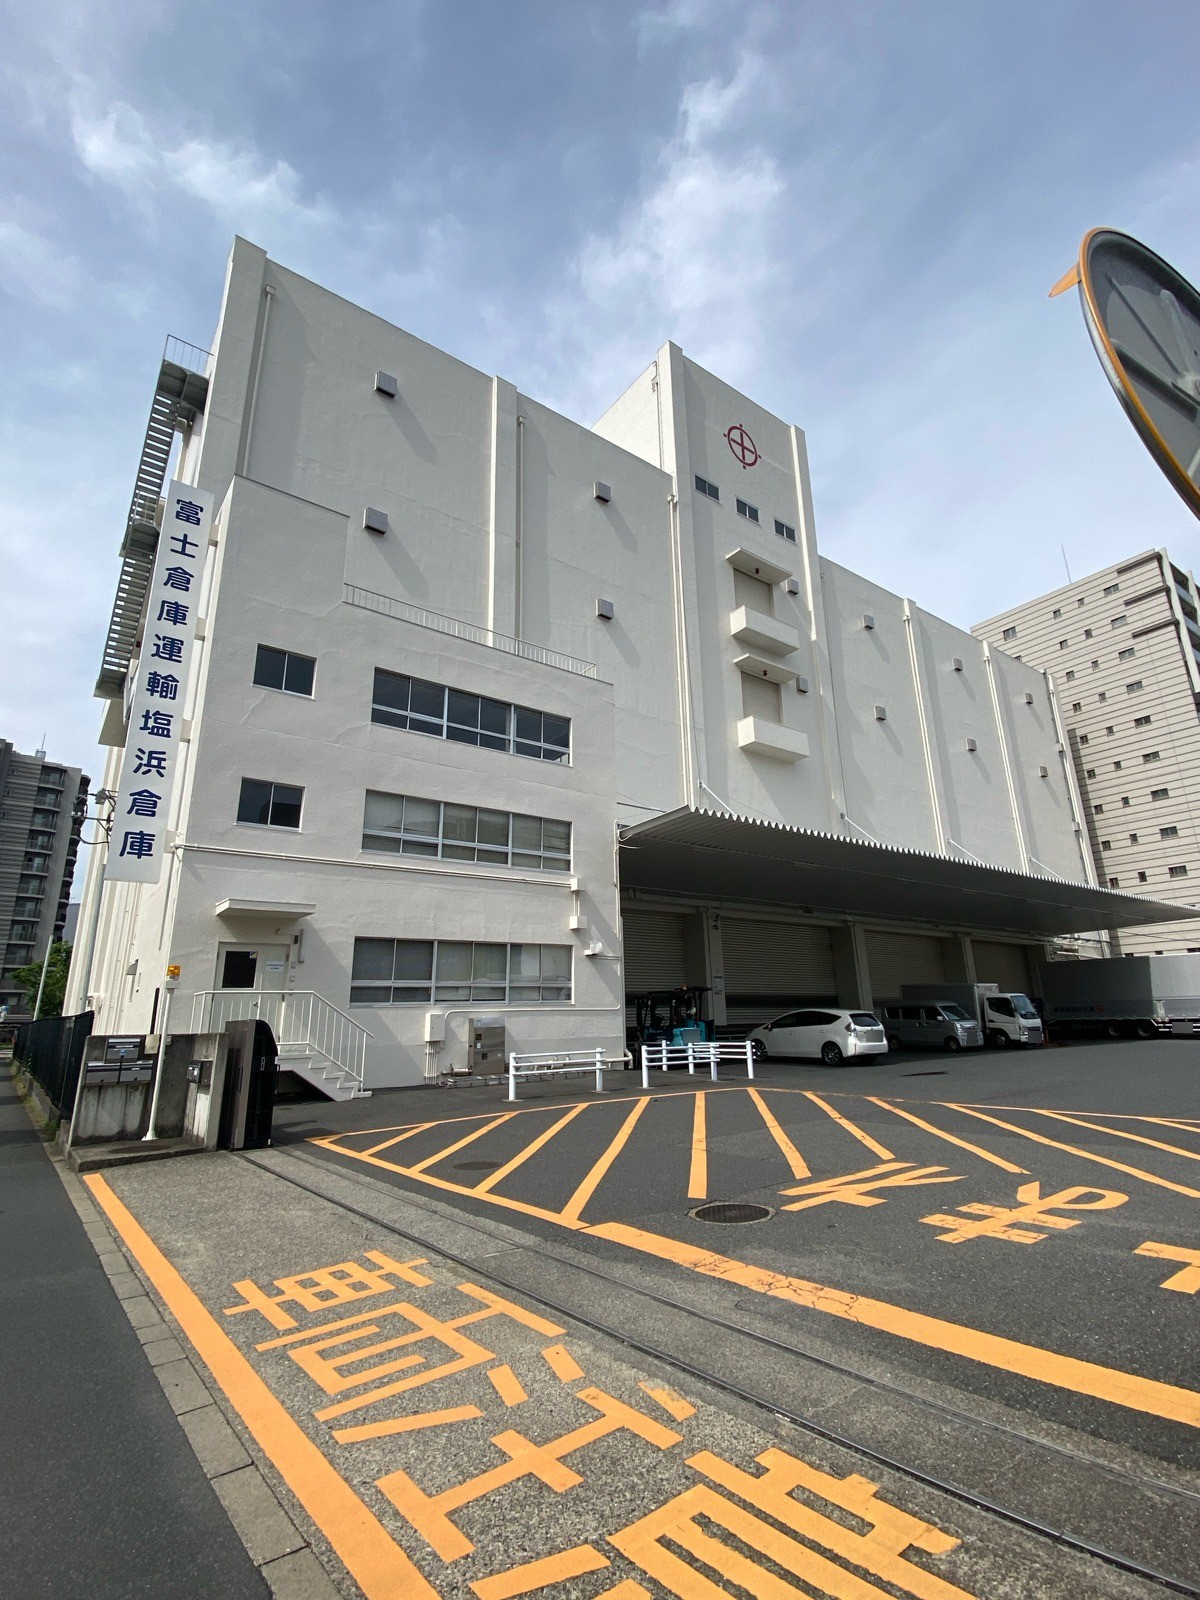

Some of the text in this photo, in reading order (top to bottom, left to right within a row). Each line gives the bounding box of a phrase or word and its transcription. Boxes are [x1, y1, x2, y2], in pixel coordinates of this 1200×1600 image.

[119, 498, 206, 859] 富士倉庫運輸塩浜倉庫
